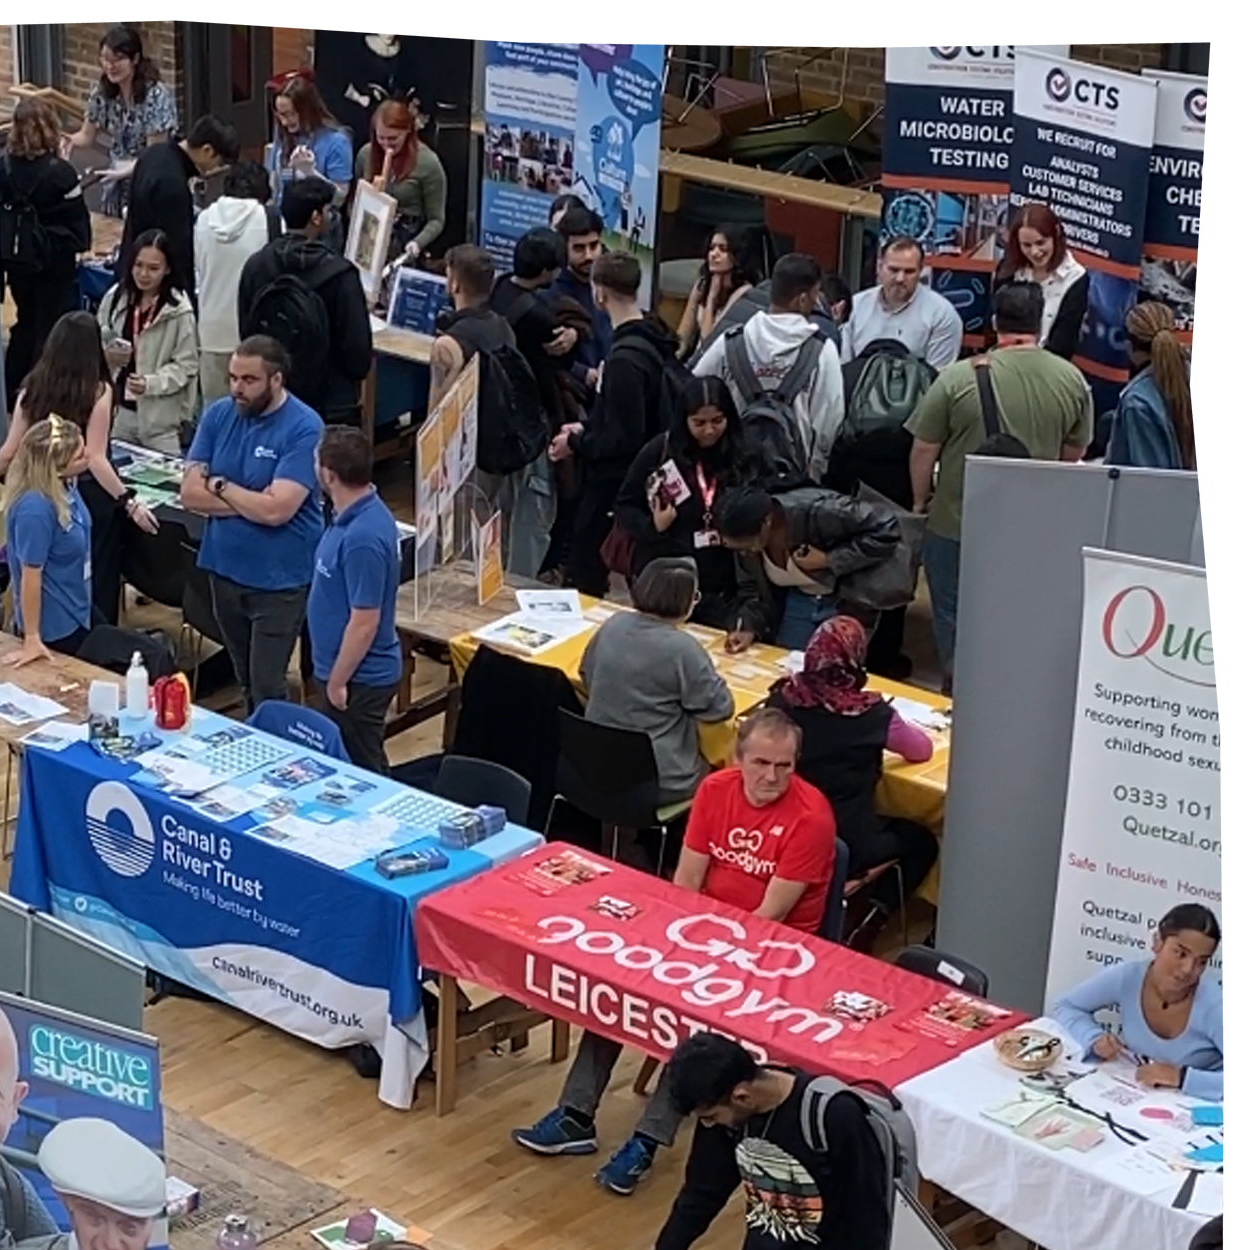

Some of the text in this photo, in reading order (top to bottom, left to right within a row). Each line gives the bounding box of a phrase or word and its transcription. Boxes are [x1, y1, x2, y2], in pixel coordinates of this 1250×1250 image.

[966, 34, 1024, 59] CTS
[940, 96, 1005, 116] WATER
[1074, 79, 1120, 110] CTS
[929, 147, 1009, 170] TESTING
[1037, 128, 1116, 159] WE RECRUIT FOR
[1022, 165, 1123, 202] CUSTOMER SERVICES
[1149, 156, 1229, 182] ENVIRON
[1028, 183, 1114, 216] LAB TECHNICIANS
[1094, 683, 1181, 717] Supporting
[1085, 708, 1164, 738] recovering
[1170, 724, 1206, 744] from
[1105, 737, 1183, 763] childhood
[1113, 785, 1168, 810] 0333
[1177, 798, 1212, 821] 101
[161, 815, 232, 860] Canal &
[161, 840, 264, 901] River Trust
[1068, 853, 1097, 872] Safe
[1105, 862, 1168, 889] Inclusive
[162, 870, 300, 938] Making life better by water
[1082, 900, 1143, 925] Quetzal
[1080, 923, 1146, 950] inclusive
[212, 956, 364, 1029] canalrivertrust.org.uk
[32, 1027, 147, 1085] creative
[34, 1056, 149, 1106] SUPPORT
